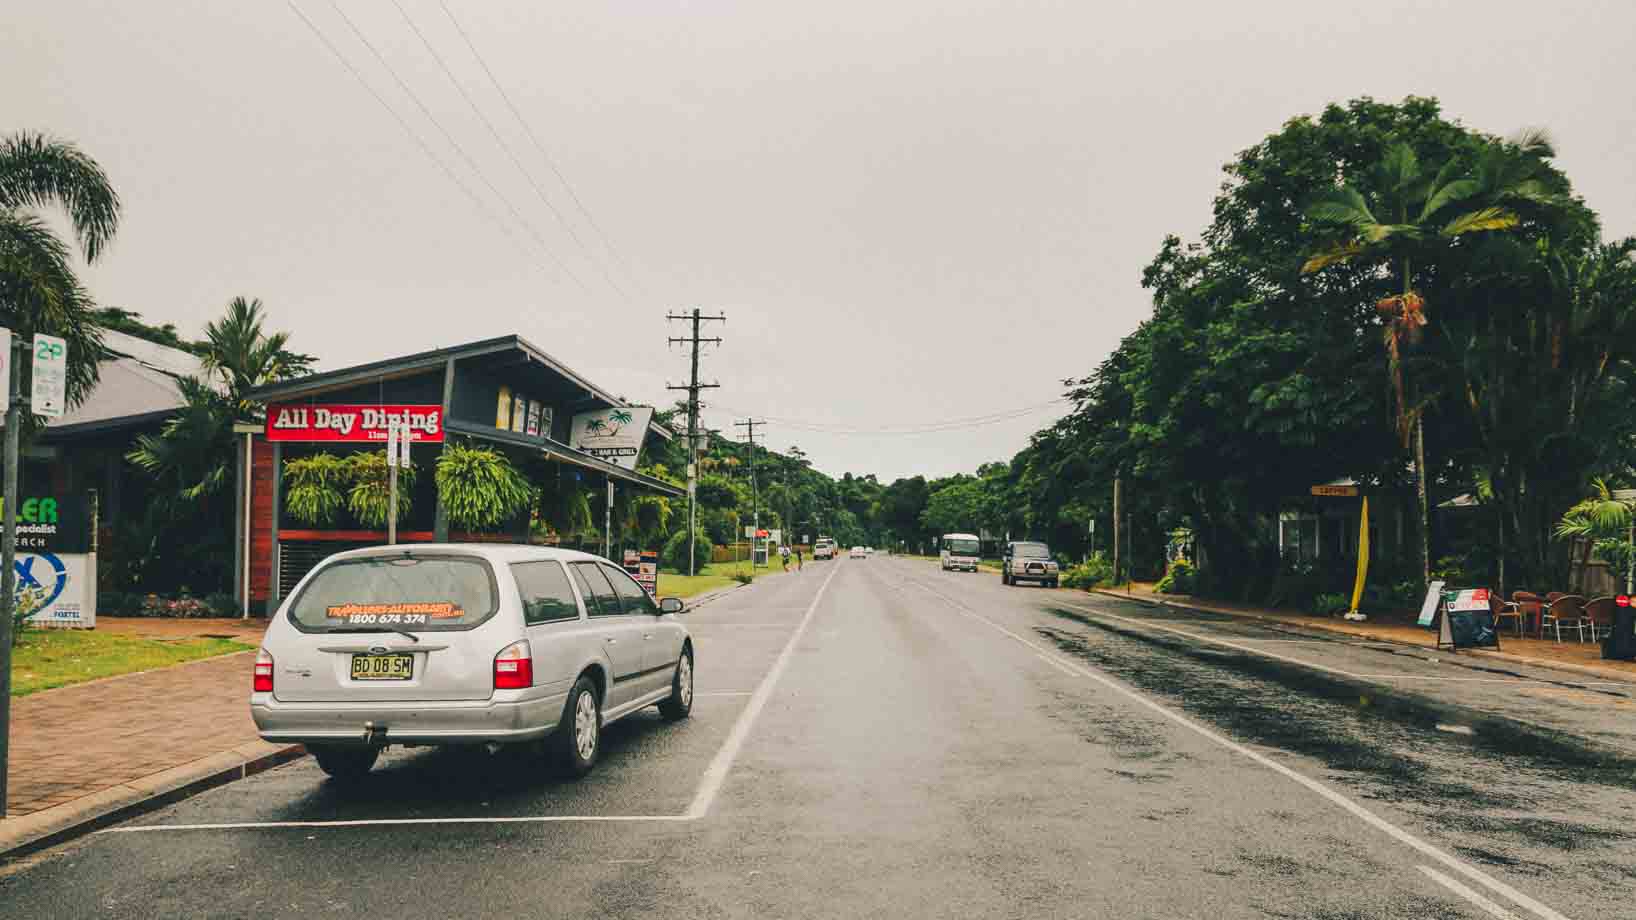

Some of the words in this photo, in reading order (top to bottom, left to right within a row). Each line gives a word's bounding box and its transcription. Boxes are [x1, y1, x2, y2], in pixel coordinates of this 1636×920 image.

[36, 340, 63, 360] 2P
[273, 408, 308, 429] All
[313, 409, 356, 435] Day
[361, 408, 438, 434] Dining
[15, 523, 56, 535] pecialist
[350, 614, 376, 624] 1800
[379, 614, 401, 624] 674
[403, 614, 426, 624] 374
[354, 659, 370, 673] BD
[374, 658, 389, 673] 08
[394, 658, 410, 673] SM
